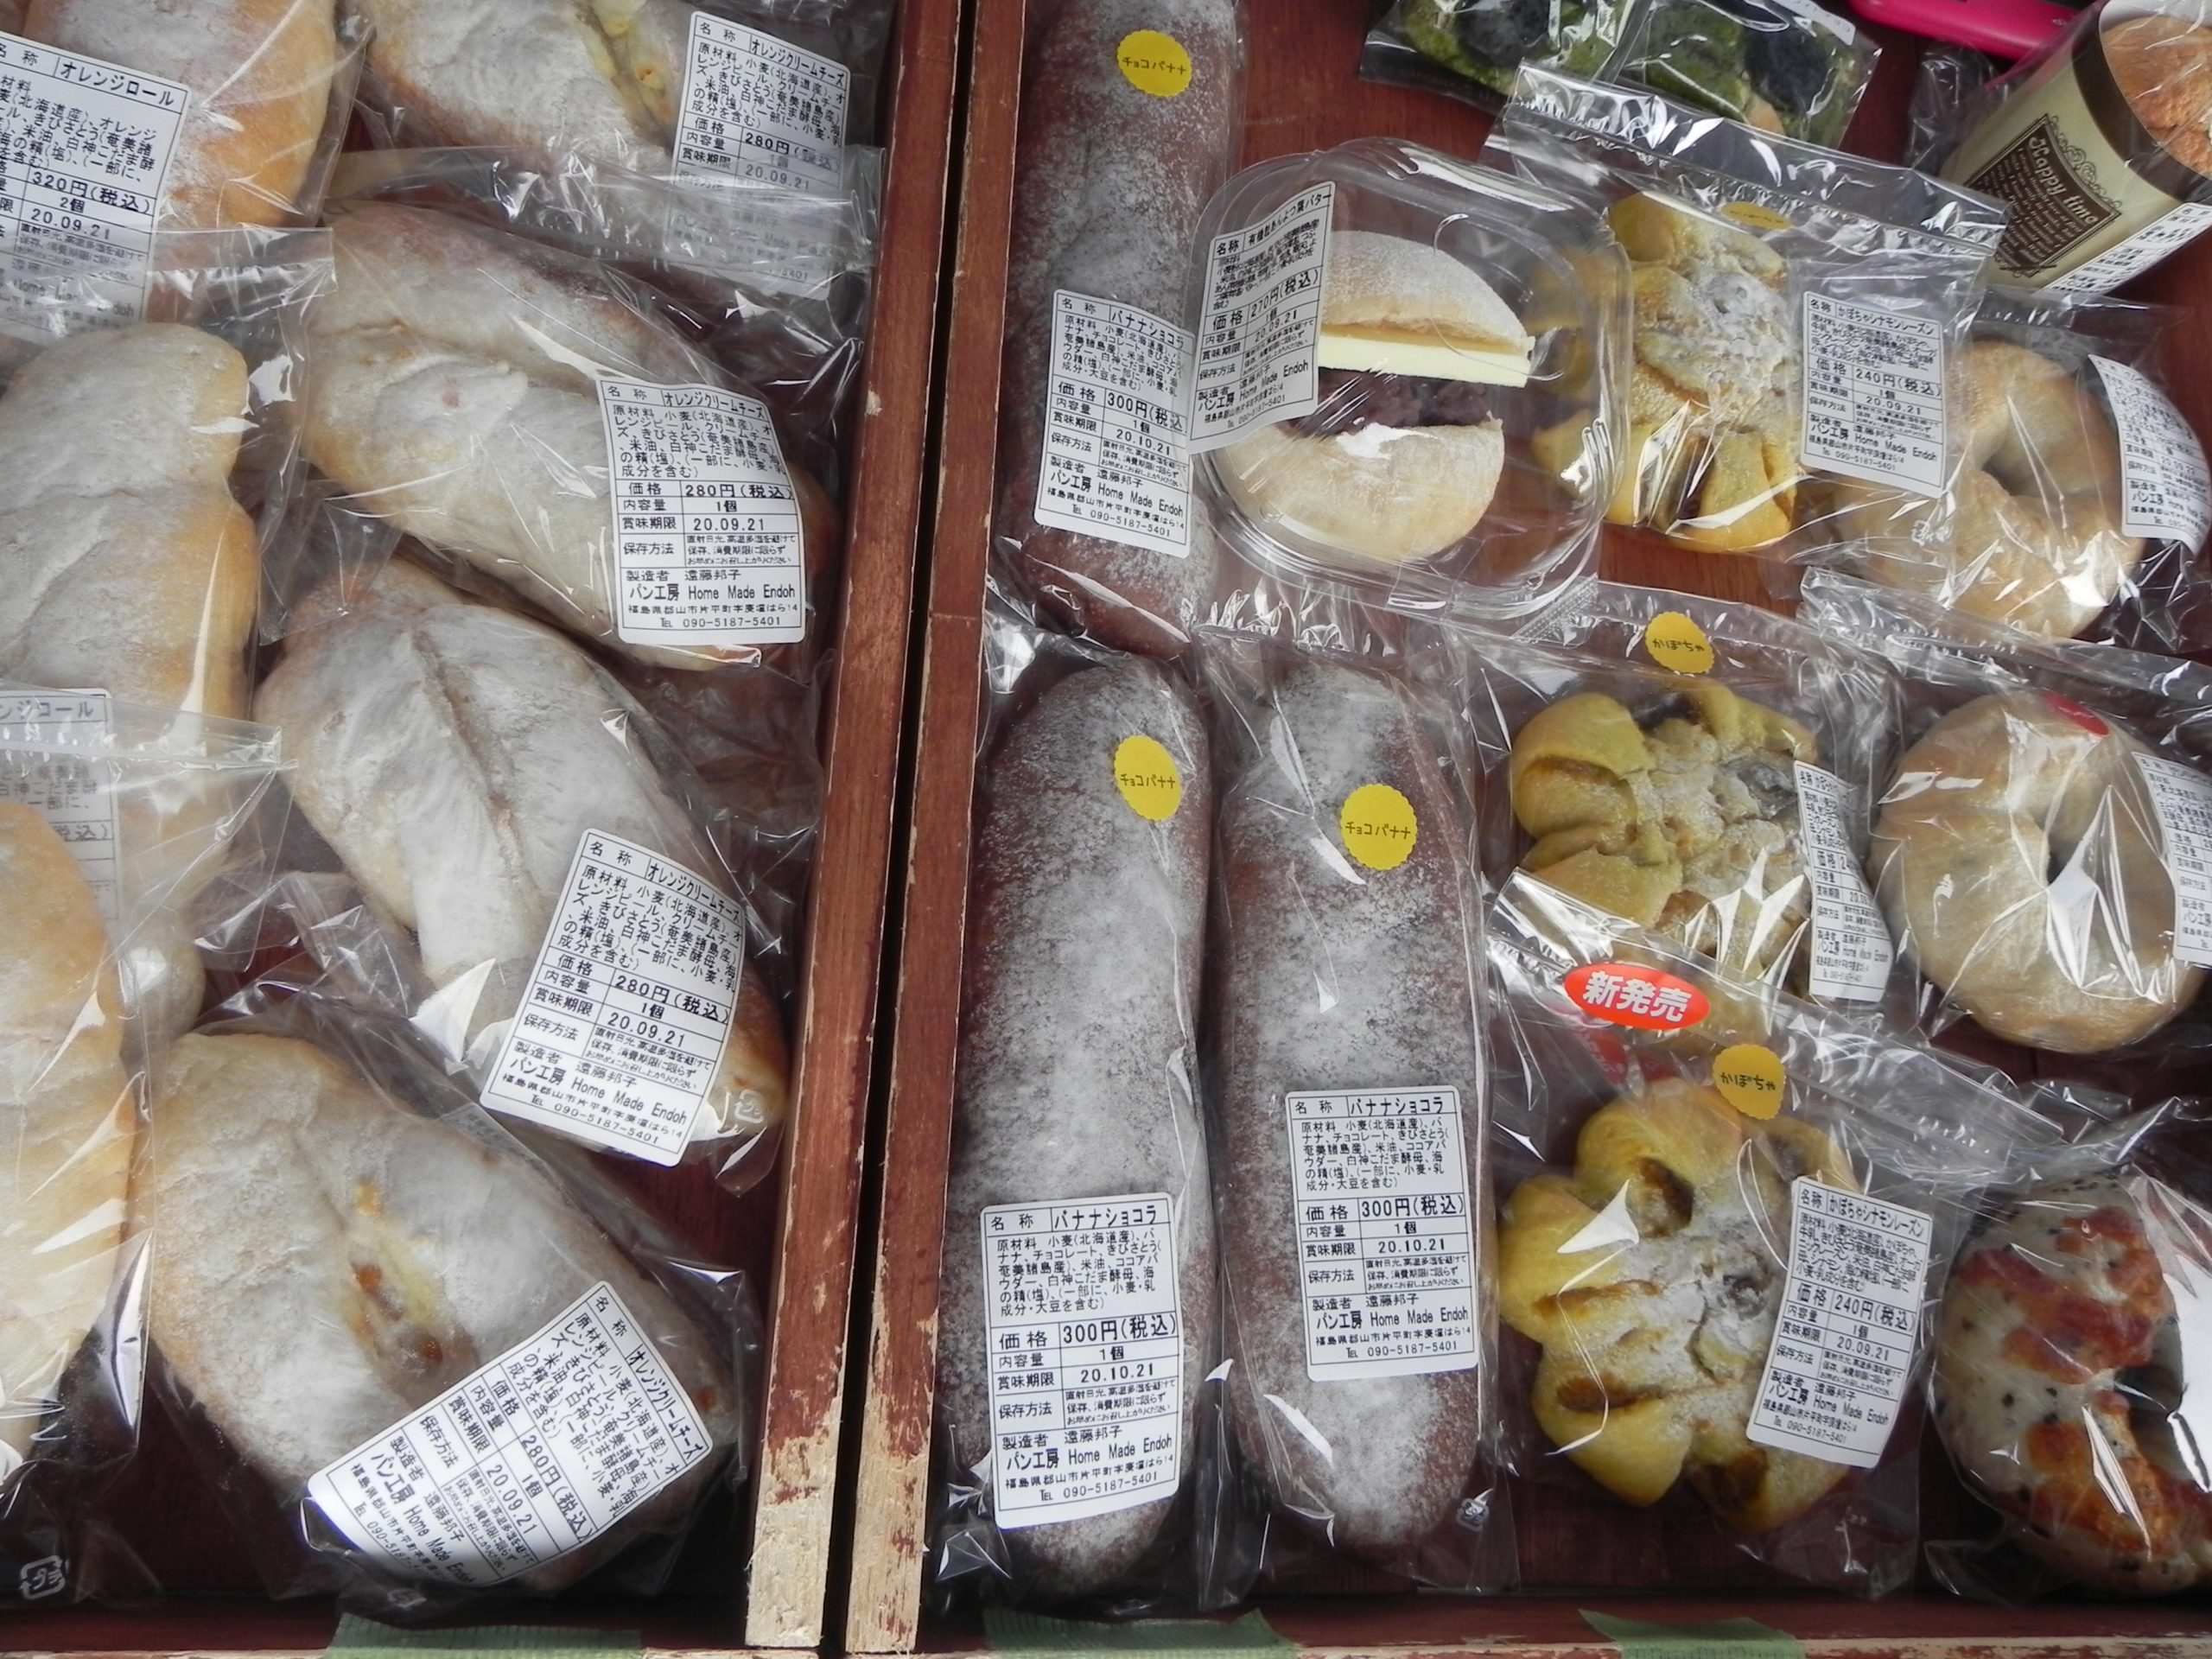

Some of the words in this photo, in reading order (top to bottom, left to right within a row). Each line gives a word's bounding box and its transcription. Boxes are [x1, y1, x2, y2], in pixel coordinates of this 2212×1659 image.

[753, 40, 845, 86] オレンジクリームチーズ
[1122, 57, 1186, 75] チョコバナナ
[60, 61, 174, 106] オレンジロール
[695, 118, 724, 135] 価格
[687, 133, 726, 149] 内容量
[683, 149, 731, 169] 賞味期限
[745, 164, 809, 190] 20.09.21
[33, 171, 150, 214] 320円(税込)
[60, 197, 85, 213] 2個
[30, 208, 110, 240] 20.09.21
[1213, 310, 1243, 332] 価格
[1251, 269, 1319, 317] 270円(税込)
[1063, 298, 1096, 315] 名称
[1111, 311, 1183, 347] バナナショコラ
[1202, 342, 1241, 361] 賞味期限
[1255, 309, 1297, 343] 20.09.21
[1205, 329, 1236, 346] 内容量
[1198, 391, 1234, 411] パン工房
[1284, 361, 1308, 378] Endoh
[1199, 364, 1236, 381] 保存方法
[1817, 358, 1847, 376] 価格
[1856, 369, 1942, 397] 240円(税込)
[608, 386, 647, 399] 名称
[664, 393, 765, 419] オレンジクリームチーズ
[1058, 381, 1096, 402] 価格
[1880, 390, 1895, 399] 1個
[1056, 397, 1091, 415] 内容量
[1133, 420, 1151, 434] 1個
[1866, 396, 1921, 415] 20.09.21
[1052, 433, 1092, 453] 保存方法
[1053, 411, 1096, 432] 賞味期限
[1116, 429, 1171, 456] 20.10.21
[1811, 423, 1848, 440] パン工房
[1855, 433, 1878, 447] Home
[1885, 439, 1906, 454] Made
[1912, 447, 1936, 462] Endoh
[1051, 456, 1085, 474] 製造者
[629, 483, 661, 495] 価格
[686, 485, 792, 499] 280円(税込)
[1051, 470, 1091, 493] パン工房
[1098, 480, 1123, 499] Home
[1130, 490, 1153, 508] Made
[1159, 499, 1183, 518] Endoh
[624, 499, 666, 511] 内容量
[716, 500, 737, 512] 1個
[623, 517, 677, 530] 賞味期限
[694, 518, 764, 531] 20.09.21
[1090, 510, 1170, 537] 090-5187-5401
[624, 543, 674, 555] 保存方法
[626, 570, 669, 582] 製造者
[630, 584, 679, 601] パン工房
[689, 586, 719, 600] Home
[728, 585, 754, 599] Made
[763, 584, 795, 598] Endoh
[683, 616, 779, 626] 090-5187-5401
[1652, 639, 1704, 652] かぼちゃ
[1120, 774, 1175, 788] チョコバナナ
[1345, 822, 1411, 839] チョコバナナ
[590, 842, 631, 865] 名称
[649, 862, 741, 923] オレンジクリームチーズ
[543, 970, 591, 995] 内容量
[641, 1001, 663, 1019] 1個
[558, 954, 592, 976] 価格
[615, 976, 728, 1022] 280円(税込)
[1583, 970, 1692, 1023] 新発売
[524, 1014, 579, 1041] 保存方法
[532, 988, 593, 1016] 賞味期限
[607, 1012, 685, 1047] 20.09.21
[514, 1042, 562, 1065] 製造者
[511, 1058, 567, 1086] パン工房
[571, 1072, 605, 1098] Home
[616, 1088, 644, 1111] Made
[652, 1102, 687, 1126] Endoh
[1720, 1072, 1775, 1090] かぼちゃ
[1295, 1101, 1332, 1115] 名称
[1351, 1096, 1444, 1116] バナナショコラ
[555, 1103, 658, 1145] 090-5187-5401
[991, 1214, 1033, 1230] 名称
[1054, 1205, 1157, 1230] バナナショコラ
[1306, 1205, 1348, 1221] 価格
[1362, 1195, 1464, 1218] 300円(税込)
[1306, 1224, 1345, 1238] 内容量
[1395, 1221, 1417, 1234] 1個
[997, 1236, 1037, 1251] 原材料
[1306, 1242, 1356, 1257] 賞味期限
[1378, 1238, 1445, 1254] 20.10.21
[1308, 1269, 1354, 1283] 保存方法
[1313, 1297, 1352, 1311] 製造者
[1366, 1294, 1419, 1308] 遠藤邦子
[1797, 1283, 1826, 1306] 価格
[1834, 1297, 1915, 1332] 240円(税込)
[999, 1331, 1047, 1351] 価格
[1063, 1313, 1176, 1344] 300円(税込)
[1316, 1311, 1362, 1331] パン工房
[1370, 1312, 1399, 1326] Home
[1407, 1310, 1433, 1325] Made
[1440, 1306, 1468, 1323] Endoh
[1788, 1305, 1817, 1323] 内容量
[1853, 1325, 1868, 1338] 1個
[1367, 1341, 1457, 1357] 090-5187-5401
[1777, 1344, 1814, 1365] 保存方法
[1782, 1321, 1821, 1342] 賞味期限
[1838, 1337, 1890, 1362] 20.09.21
[999, 1352, 1044, 1369] 内容量
[1100, 1345, 1125, 1362] 1個
[997, 1372, 1055, 1390] 賞味期限
[1081, 1363, 1154, 1383] 20.10.21
[627, 1351, 703, 1459] オレンジクリームチーズ
[999, 1402, 1052, 1419] 保存方法
[1769, 1383, 1809, 1407] パン工房
[1814, 1395, 1837, 1413] Home
[1844, 1402, 1862, 1419] Made
[1867, 1408, 1889, 1426] Endoh
[420, 1415, 459, 1468] 保存方法
[471, 1386, 507, 1433] 内容量
[520, 1474, 543, 1497] 1個
[1002, 1434, 1049, 1450] 製造者
[1064, 1426, 1122, 1446] 遠藤邦子
[448, 1395, 490, 1453] 賞味期限
[485, 1464, 537, 1535] 20.09.21
[492, 1380, 520, 1415] 価格
[518, 1433, 594, 1544] 280円(税込)
[1007, 1448, 1059, 1471] パン工房
[1068, 1446, 1100, 1466] Home
[1109, 1440, 1135, 1460] Made
[1143, 1433, 1172, 1457] Endoh
[1064, 1471, 1157, 1499] 090-5187-5401
[371, 1453, 416, 1504] パン工房
[403, 1506, 430, 1540] Home
[426, 1537, 450, 1563] Made
